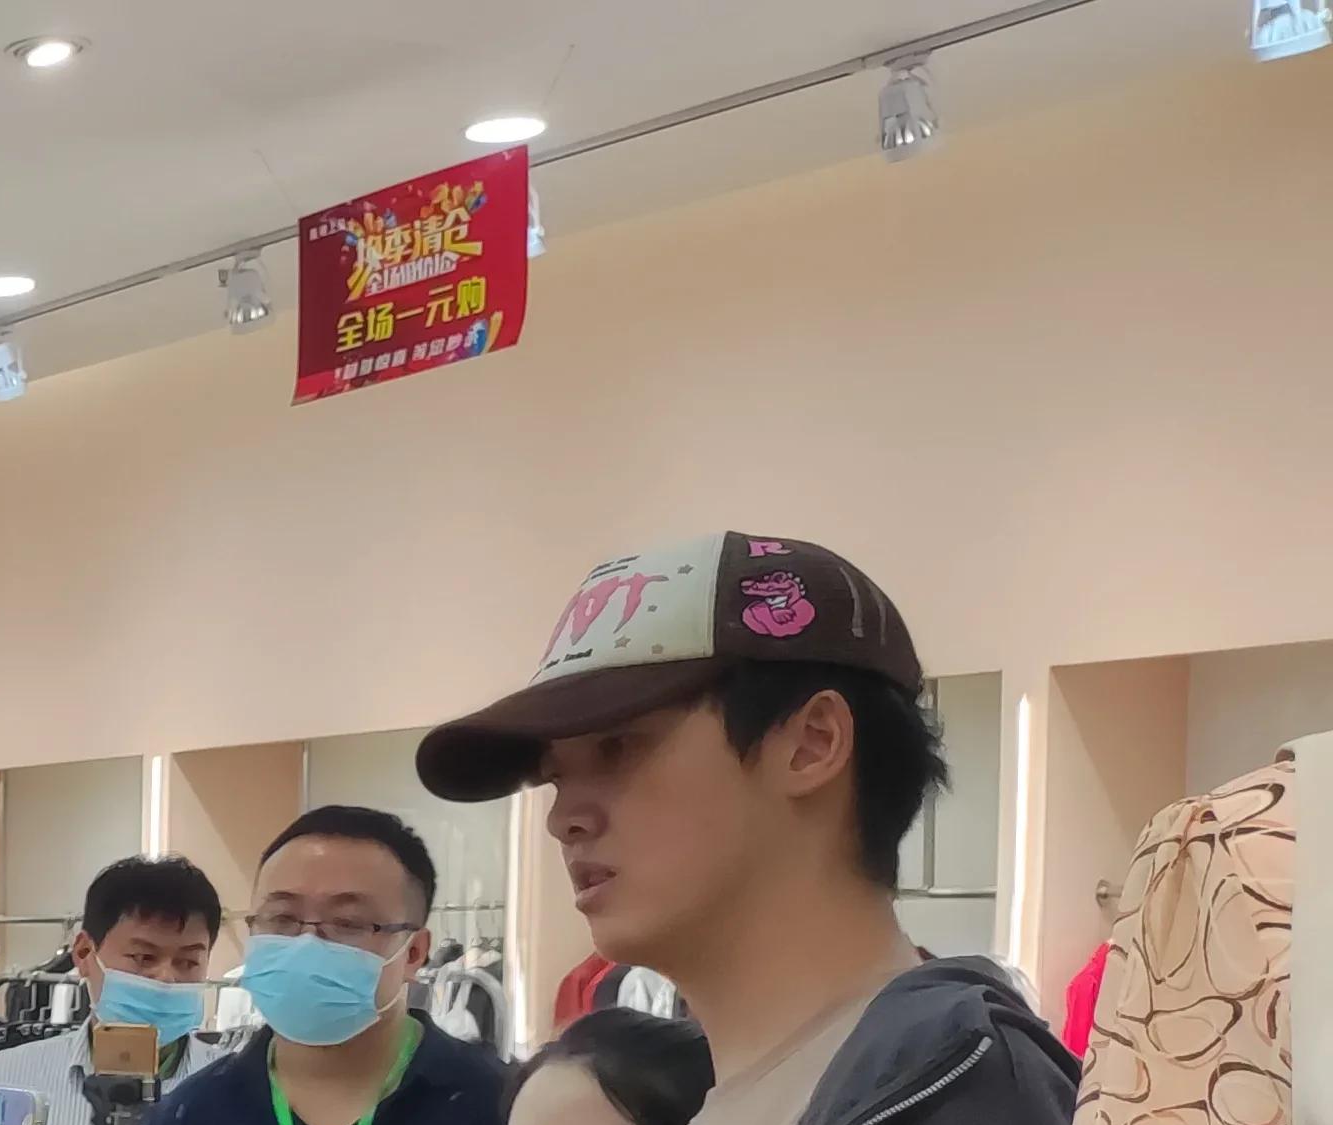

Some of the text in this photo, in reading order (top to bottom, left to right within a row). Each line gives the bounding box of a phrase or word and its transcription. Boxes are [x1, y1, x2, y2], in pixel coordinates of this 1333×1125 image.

[336, 277, 486, 352] 全场一元购
